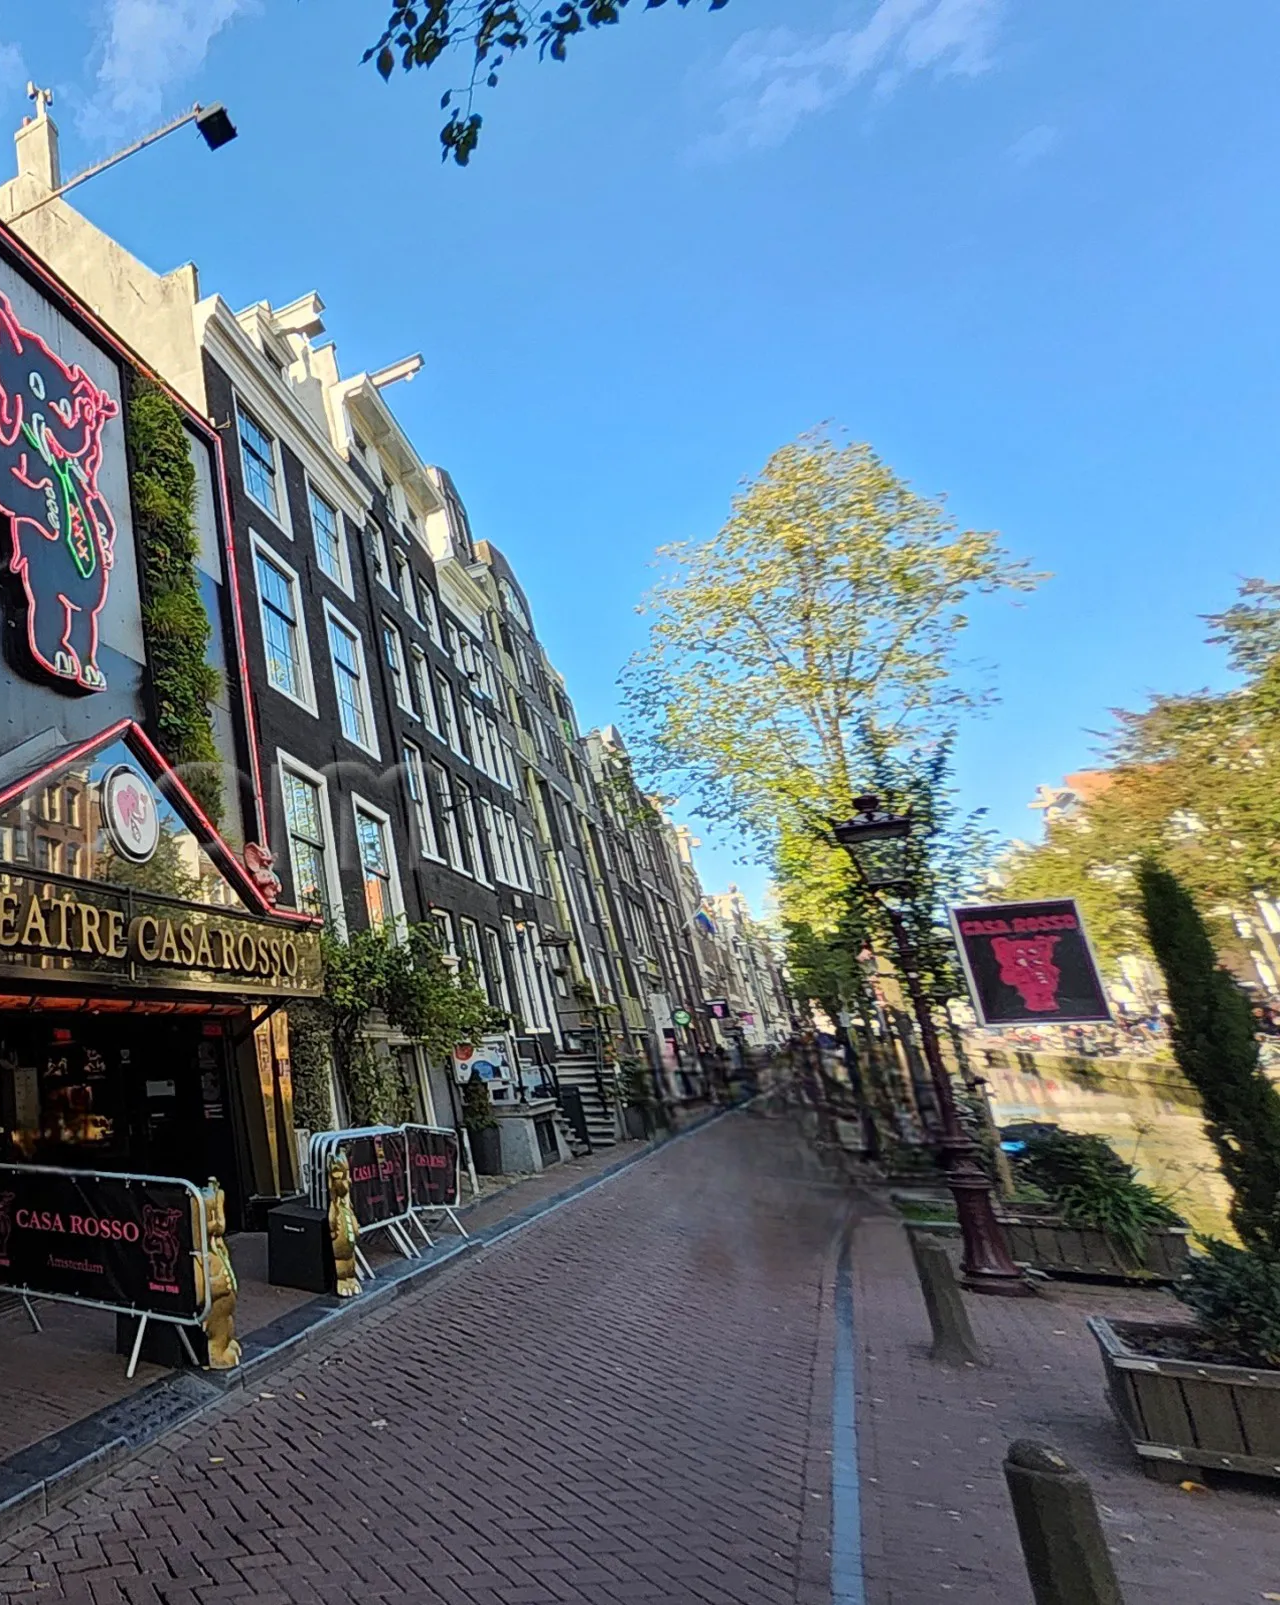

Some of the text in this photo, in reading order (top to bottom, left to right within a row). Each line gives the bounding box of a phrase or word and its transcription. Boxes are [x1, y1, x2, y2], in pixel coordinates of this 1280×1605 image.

[961, 920, 1012, 936] CASA
[137, 915, 217, 969] CASA
[221, 927, 298, 978] ROSSO
[16, 1208, 139, 1242] CASA ROSSO
[47, 1254, 104, 1275] Amsterdam
